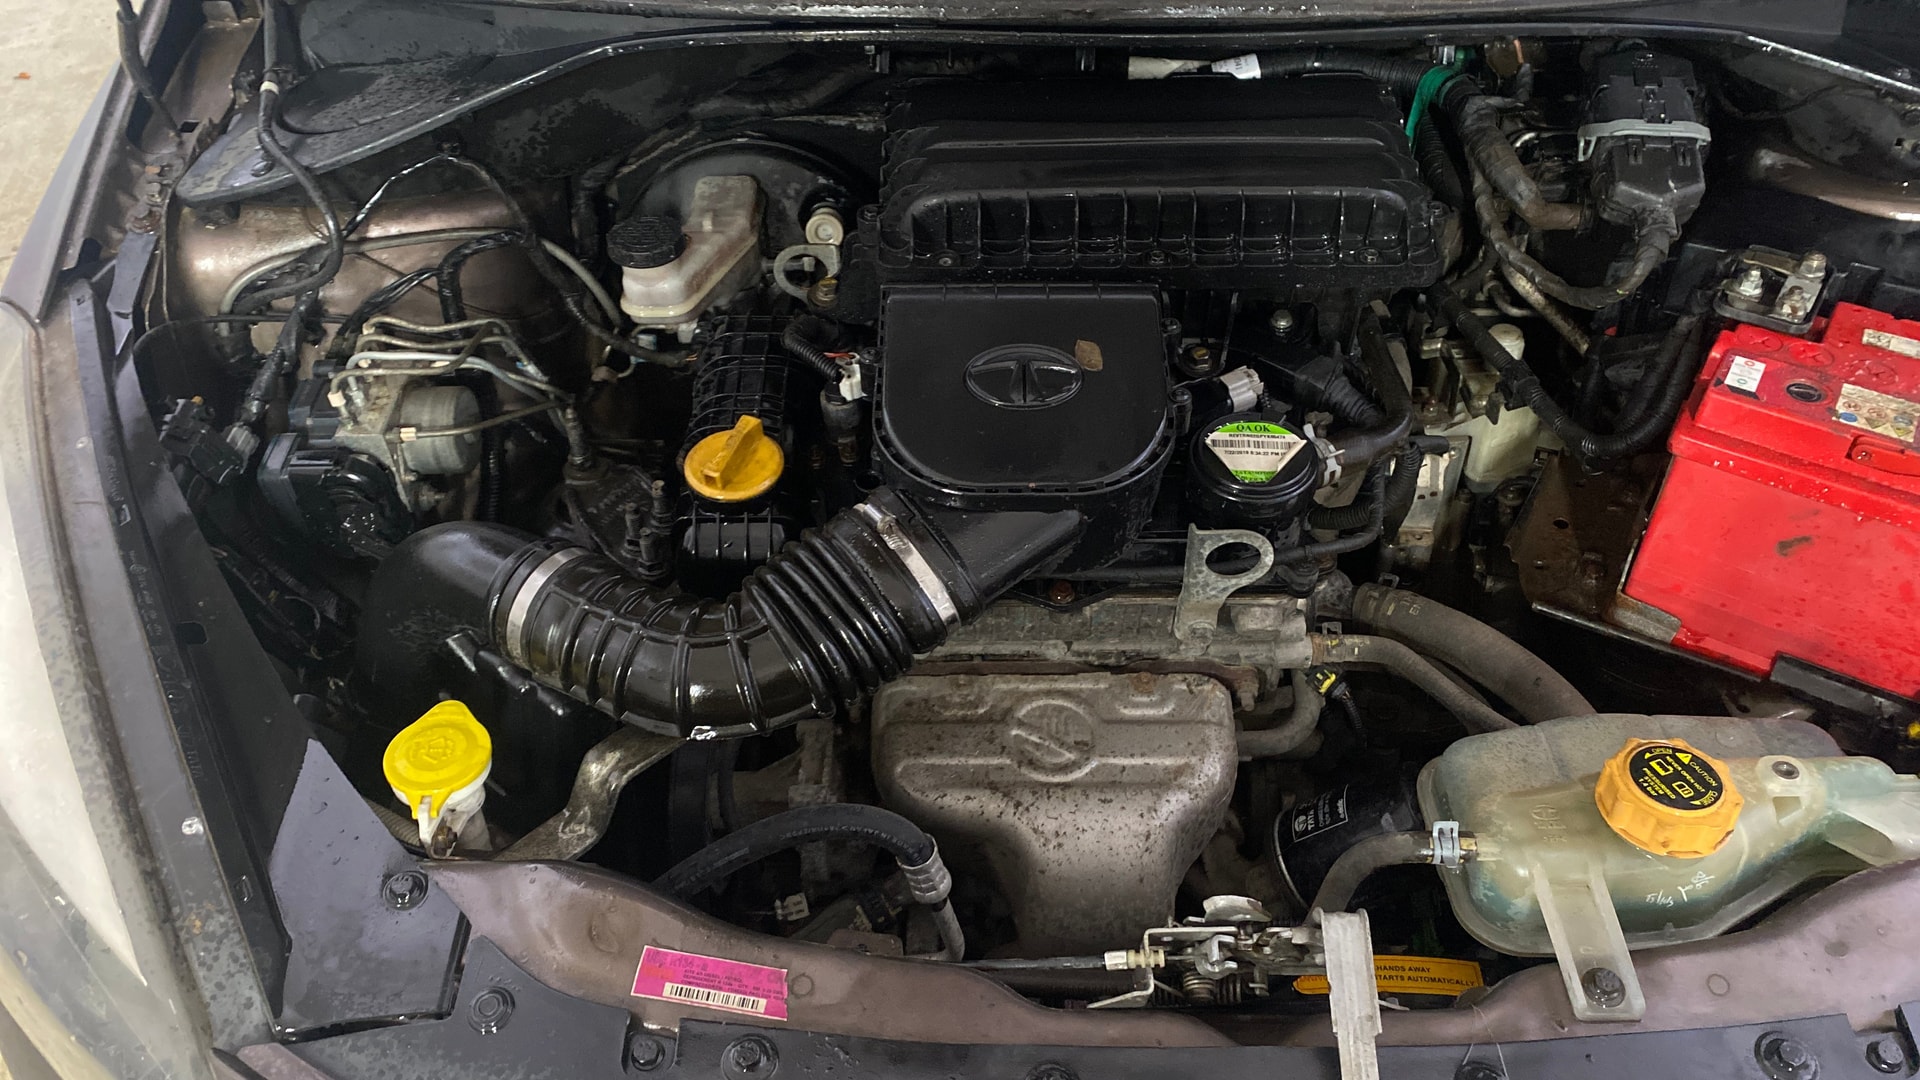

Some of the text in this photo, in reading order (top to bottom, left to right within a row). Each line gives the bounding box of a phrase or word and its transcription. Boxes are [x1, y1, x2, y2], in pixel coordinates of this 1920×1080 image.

[1236, 424, 1272, 432] QA OK
[1666, 755, 1706, 793] NEVER OPEN HOT
[1690, 761, 1718, 787] CAUTION
[1307, 809, 1315, 831] TATA
[1376, 965, 1406, 973] HANDS
[1407, 976, 1475, 987] AUTOMATICALLY
